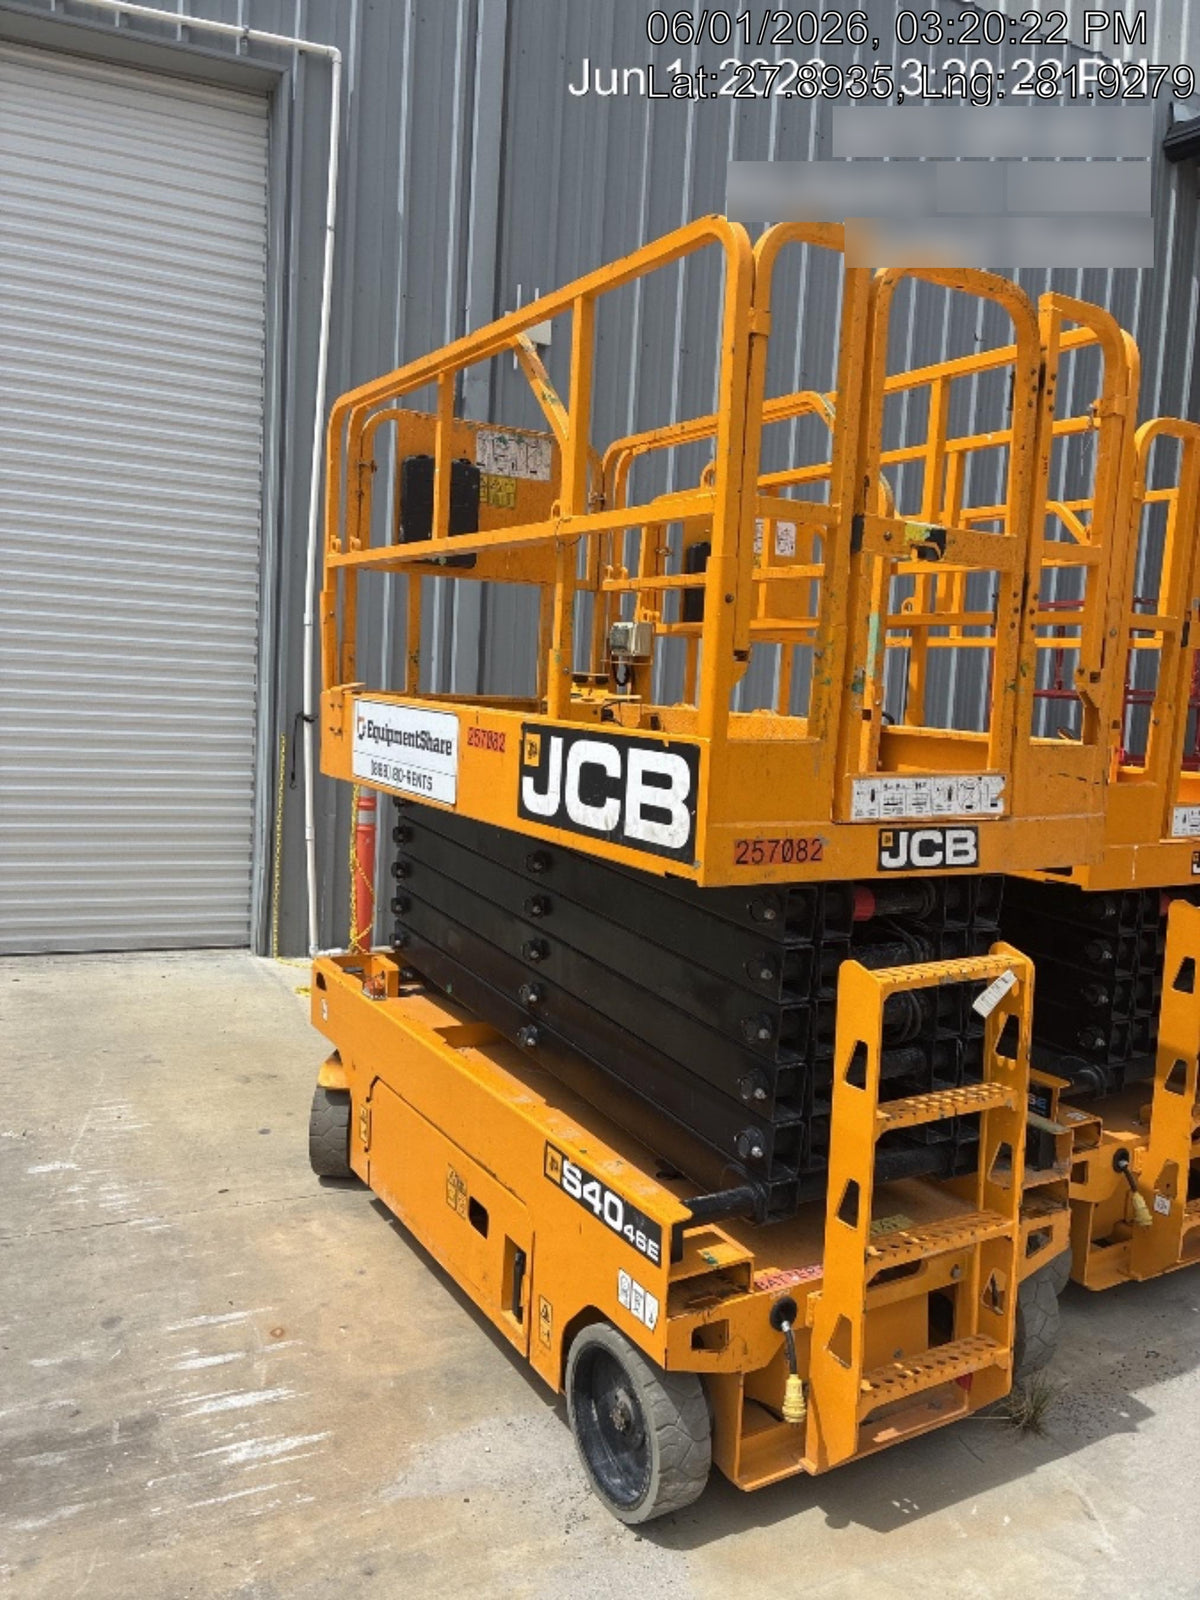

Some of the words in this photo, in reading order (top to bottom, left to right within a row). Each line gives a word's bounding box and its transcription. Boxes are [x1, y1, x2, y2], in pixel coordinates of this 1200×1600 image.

[367, 719, 452, 756] EquipmentShare
[467, 726, 506, 753] 257082
[521, 735, 691, 850] JCB
[735, 838, 824, 865] 257082
[881, 830, 977, 868] JCB
